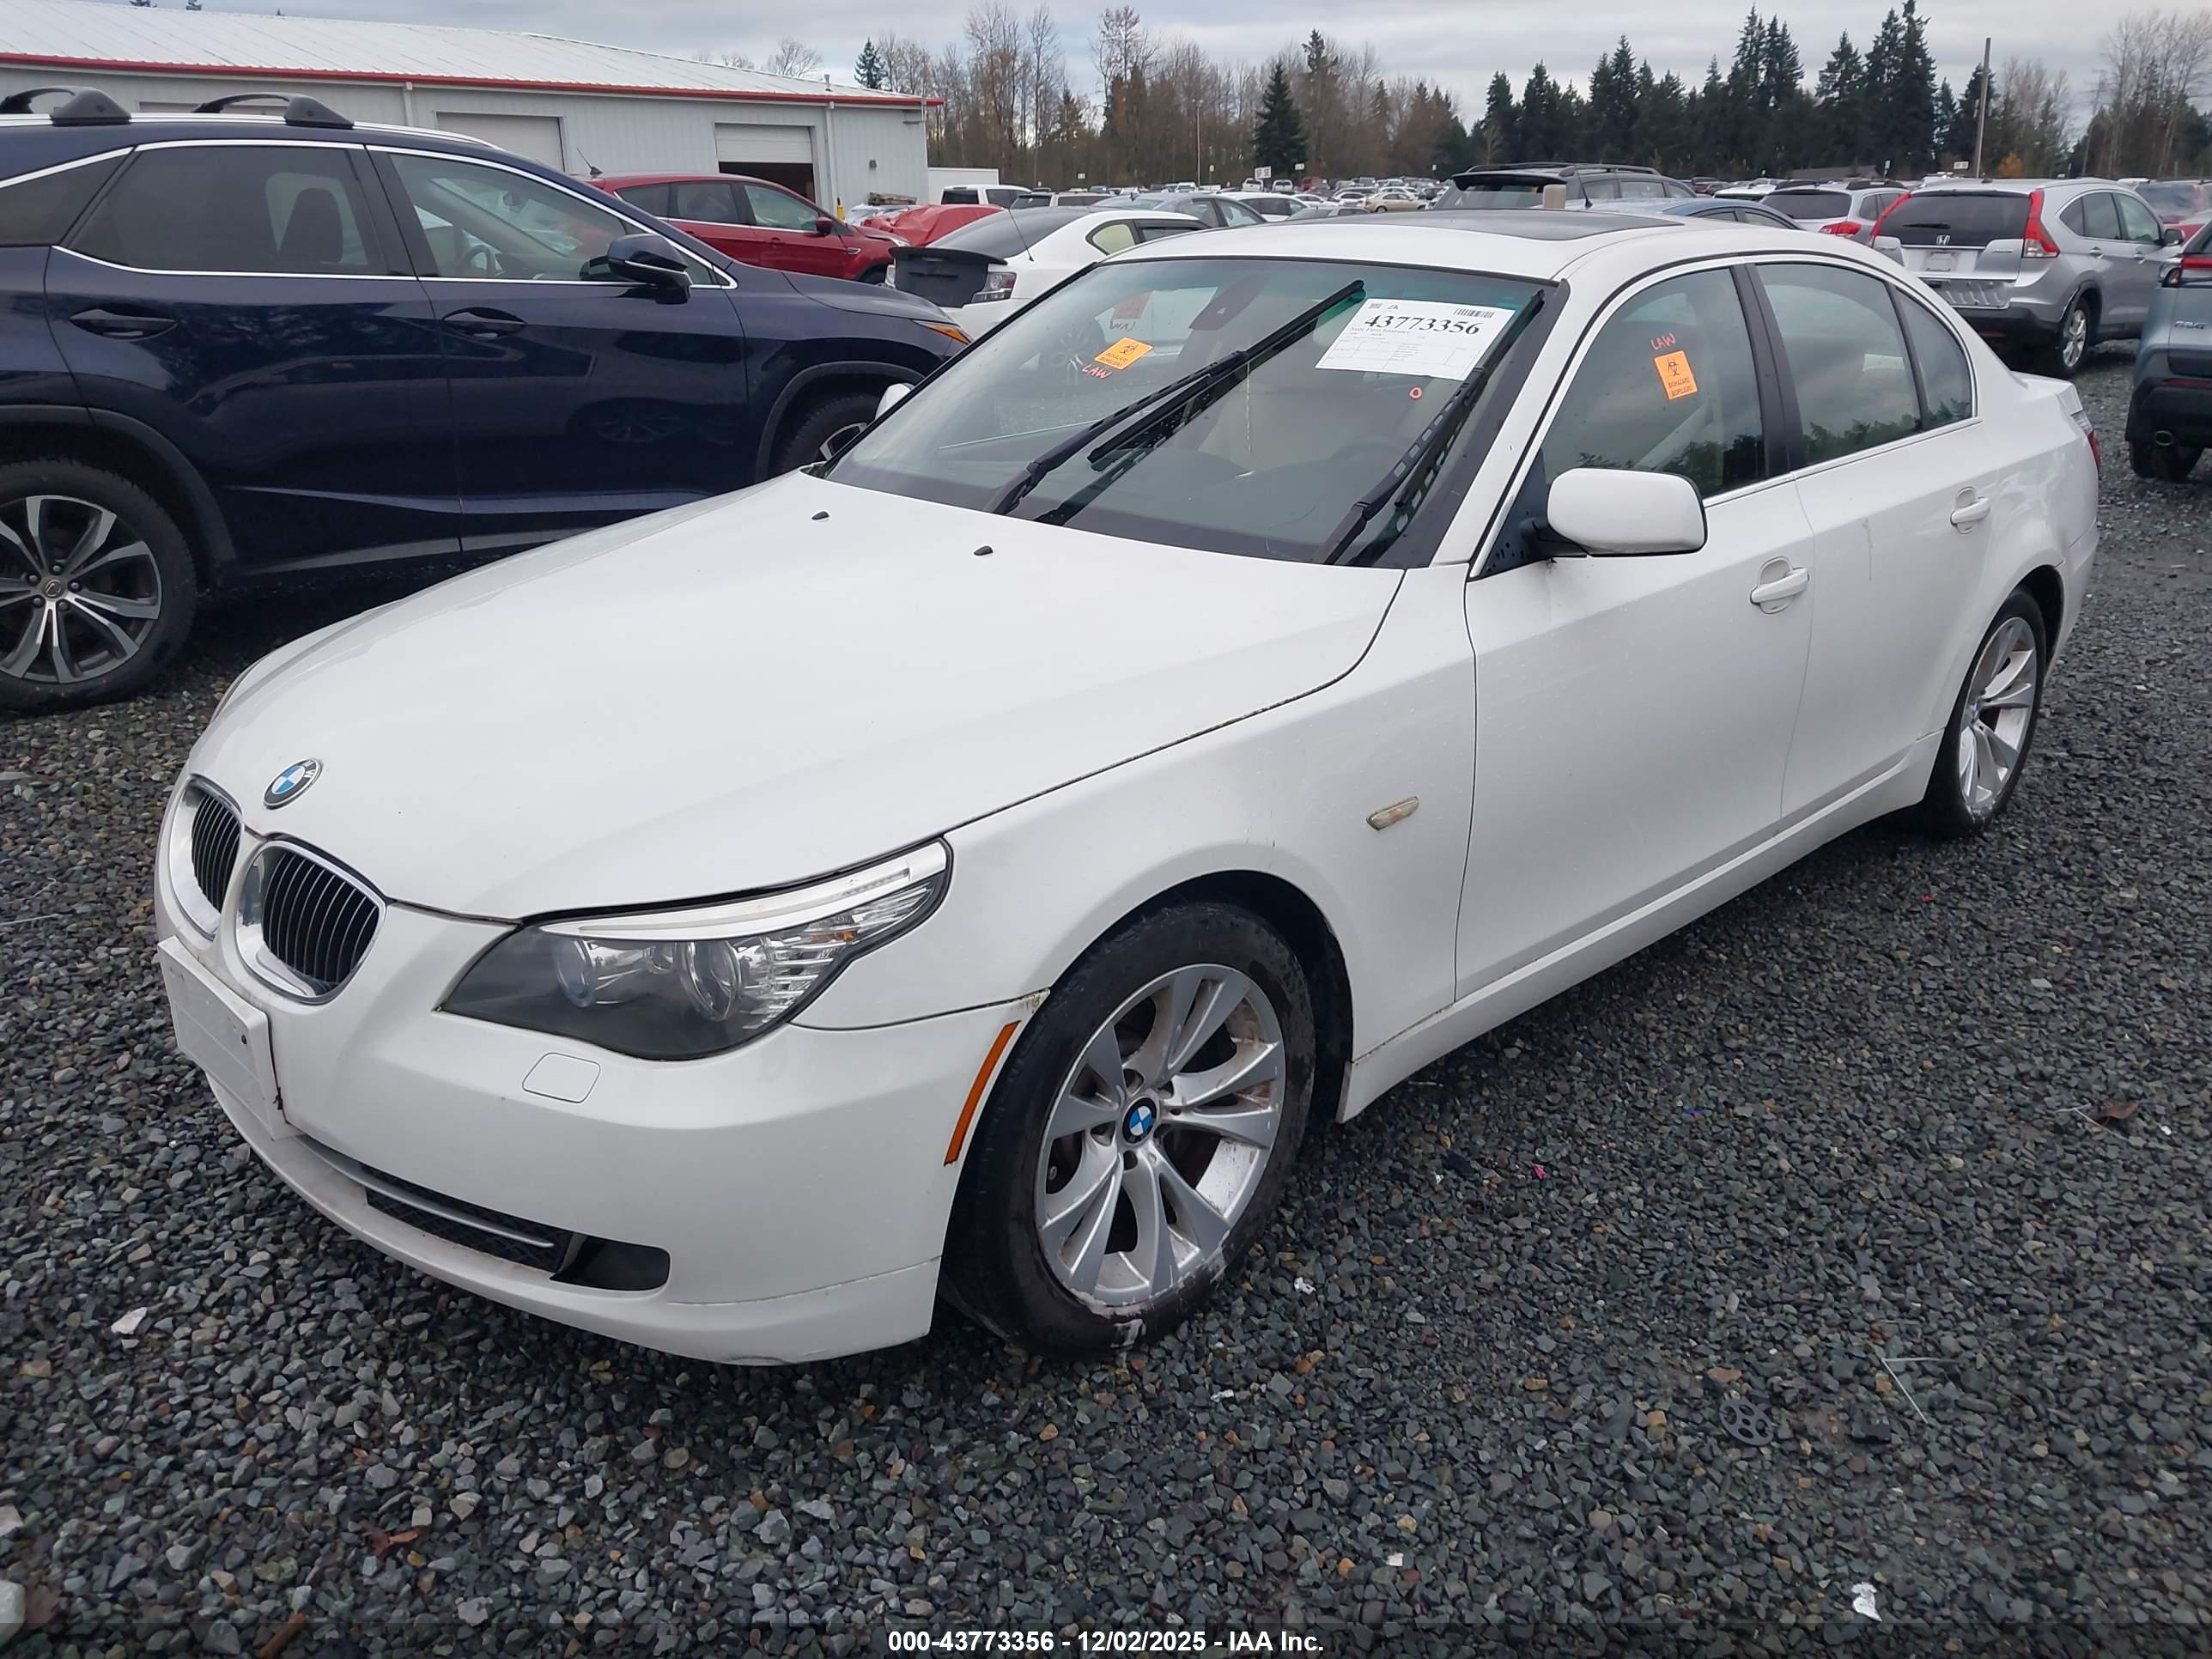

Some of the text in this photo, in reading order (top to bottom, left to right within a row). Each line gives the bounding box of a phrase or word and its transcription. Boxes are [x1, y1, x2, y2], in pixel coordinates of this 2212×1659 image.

[1364, 314, 1484, 335] 43773356
[1650, 331, 1676, 350] LAW
[1081, 363, 1113, 379] LAW
